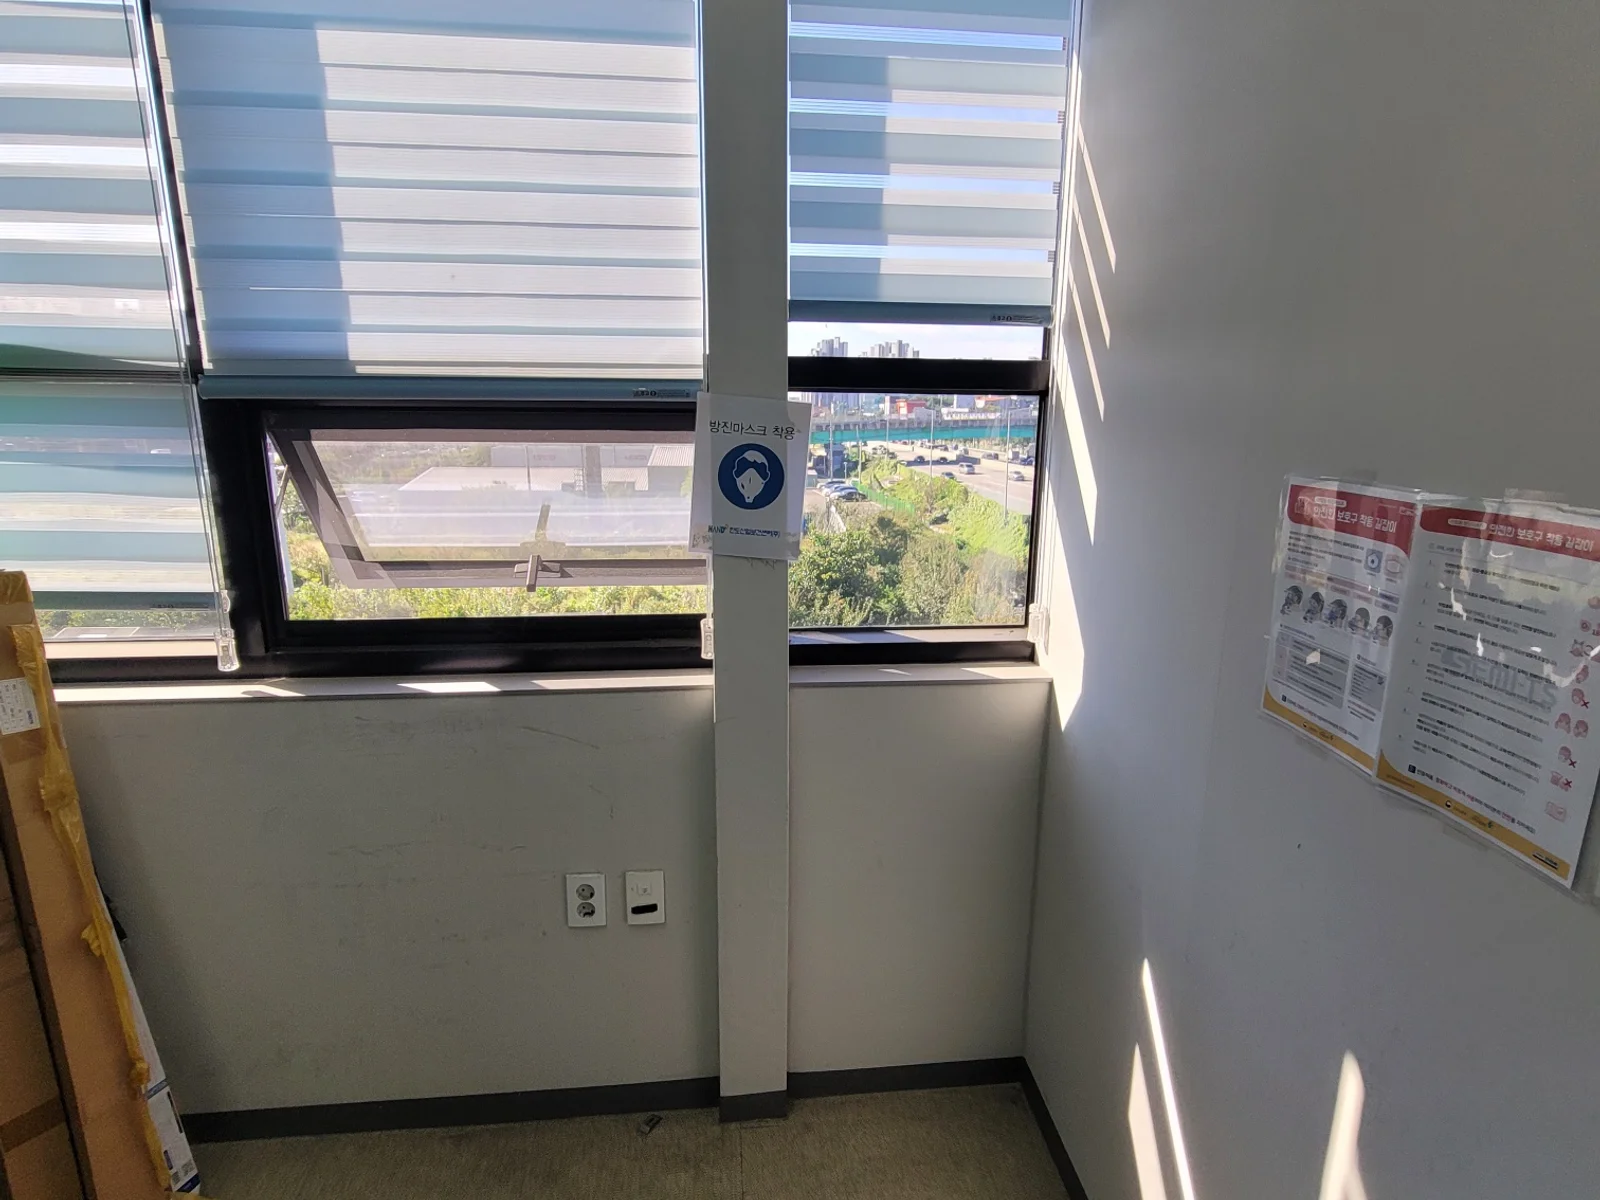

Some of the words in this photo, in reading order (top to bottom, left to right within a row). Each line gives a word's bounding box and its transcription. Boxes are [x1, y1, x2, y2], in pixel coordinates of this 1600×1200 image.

[709, 420, 767, 436] 방진마스크
[772, 426, 796, 440] 착용
[1337, 511, 1358, 524] 보호구
[1517, 528, 1543, 542] 보호구
